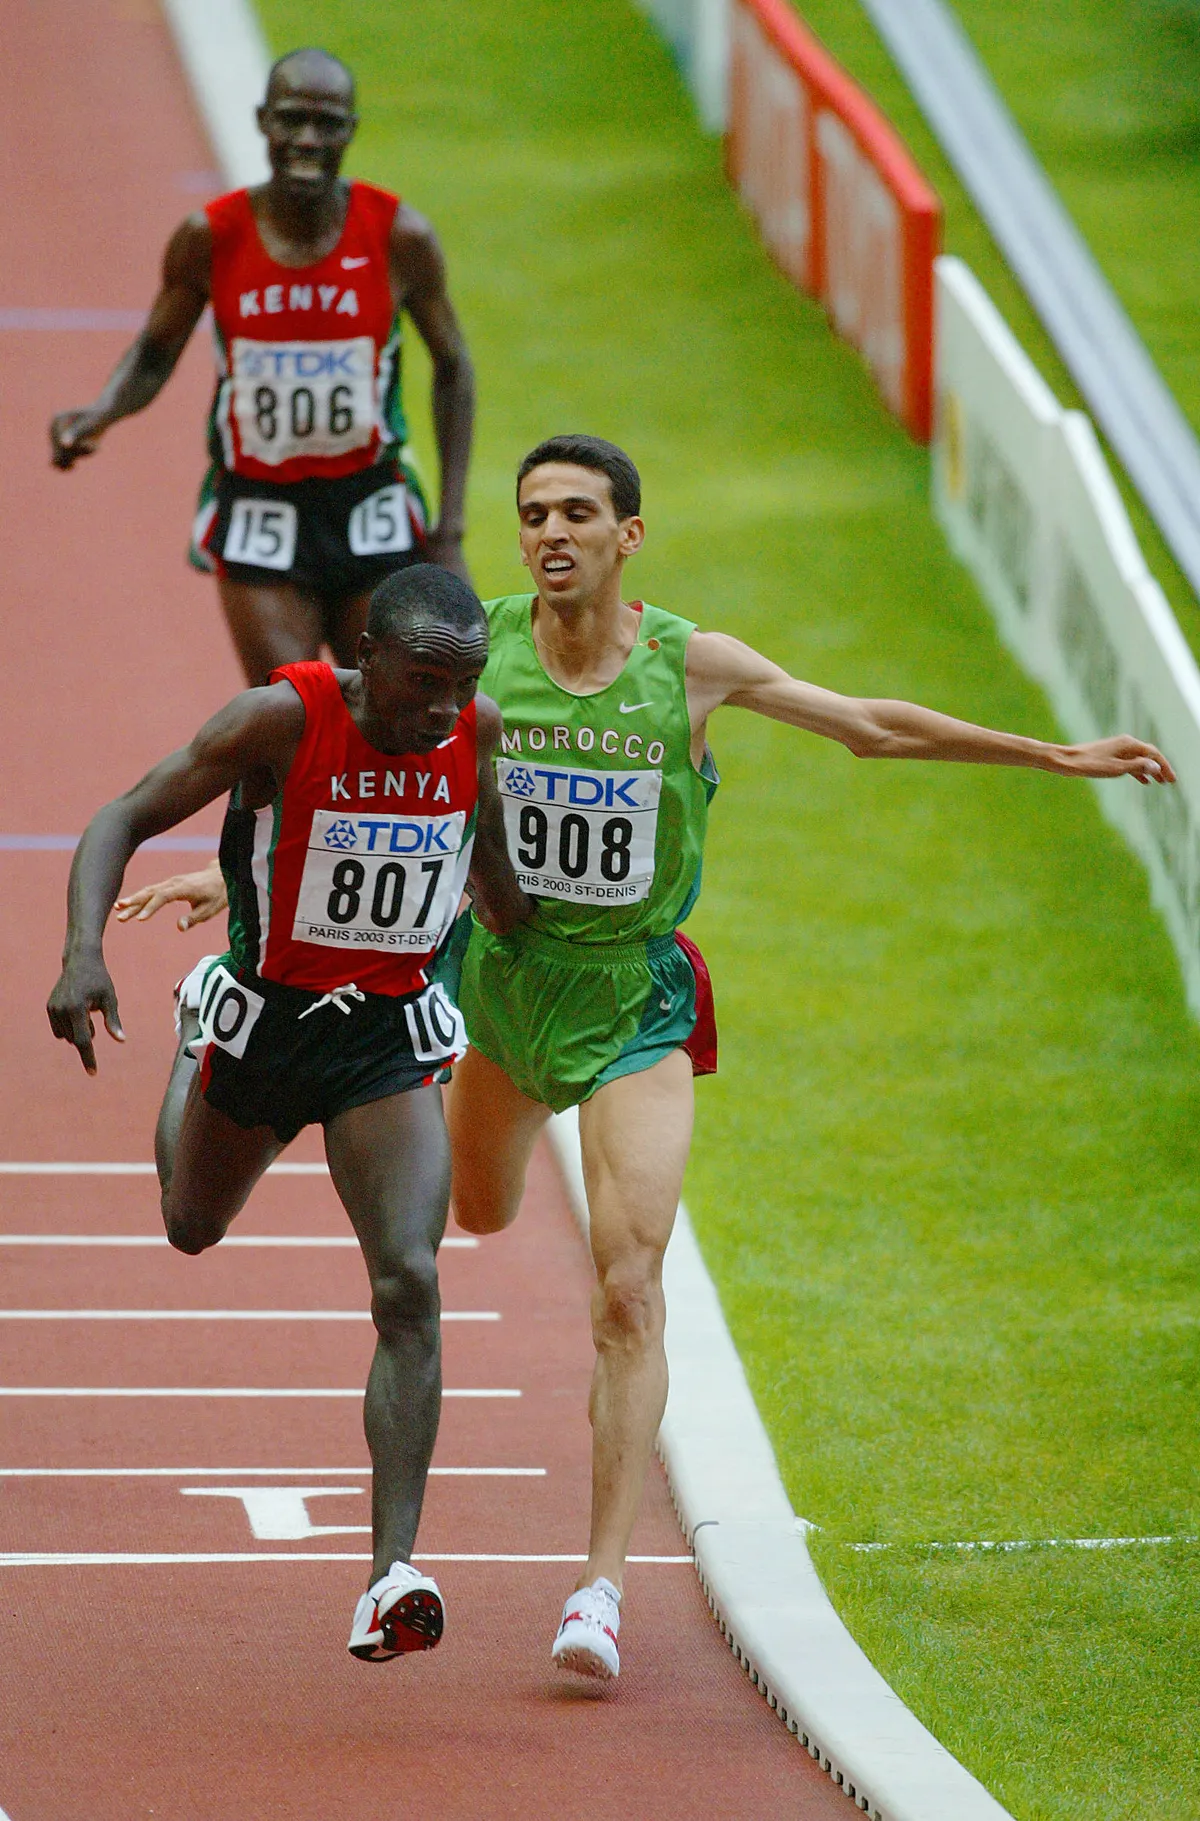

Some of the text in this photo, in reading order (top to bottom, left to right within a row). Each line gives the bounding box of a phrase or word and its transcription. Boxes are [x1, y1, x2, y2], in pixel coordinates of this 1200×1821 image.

[239, 285, 359, 318] KENYA
[271, 351, 355, 378] TDK
[254, 385, 353, 441] 806
[238, 510, 284, 557] 15
[360, 495, 398, 543] 15
[500, 725, 666, 765] MOROCCO
[330, 770, 451, 804] KENYA
[534, 769, 640, 808] TDK
[357, 820, 452, 853] TDK
[517, 805, 634, 883] 908
[326, 858, 444, 929] 807
[516, 873, 637, 898] RIS 2003 ST-DENIS
[308, 926, 350, 941] PARIS
[353, 931, 385, 944] 2003
[202, 973, 248, 1043] 10
[413, 990, 457, 1054] 10
